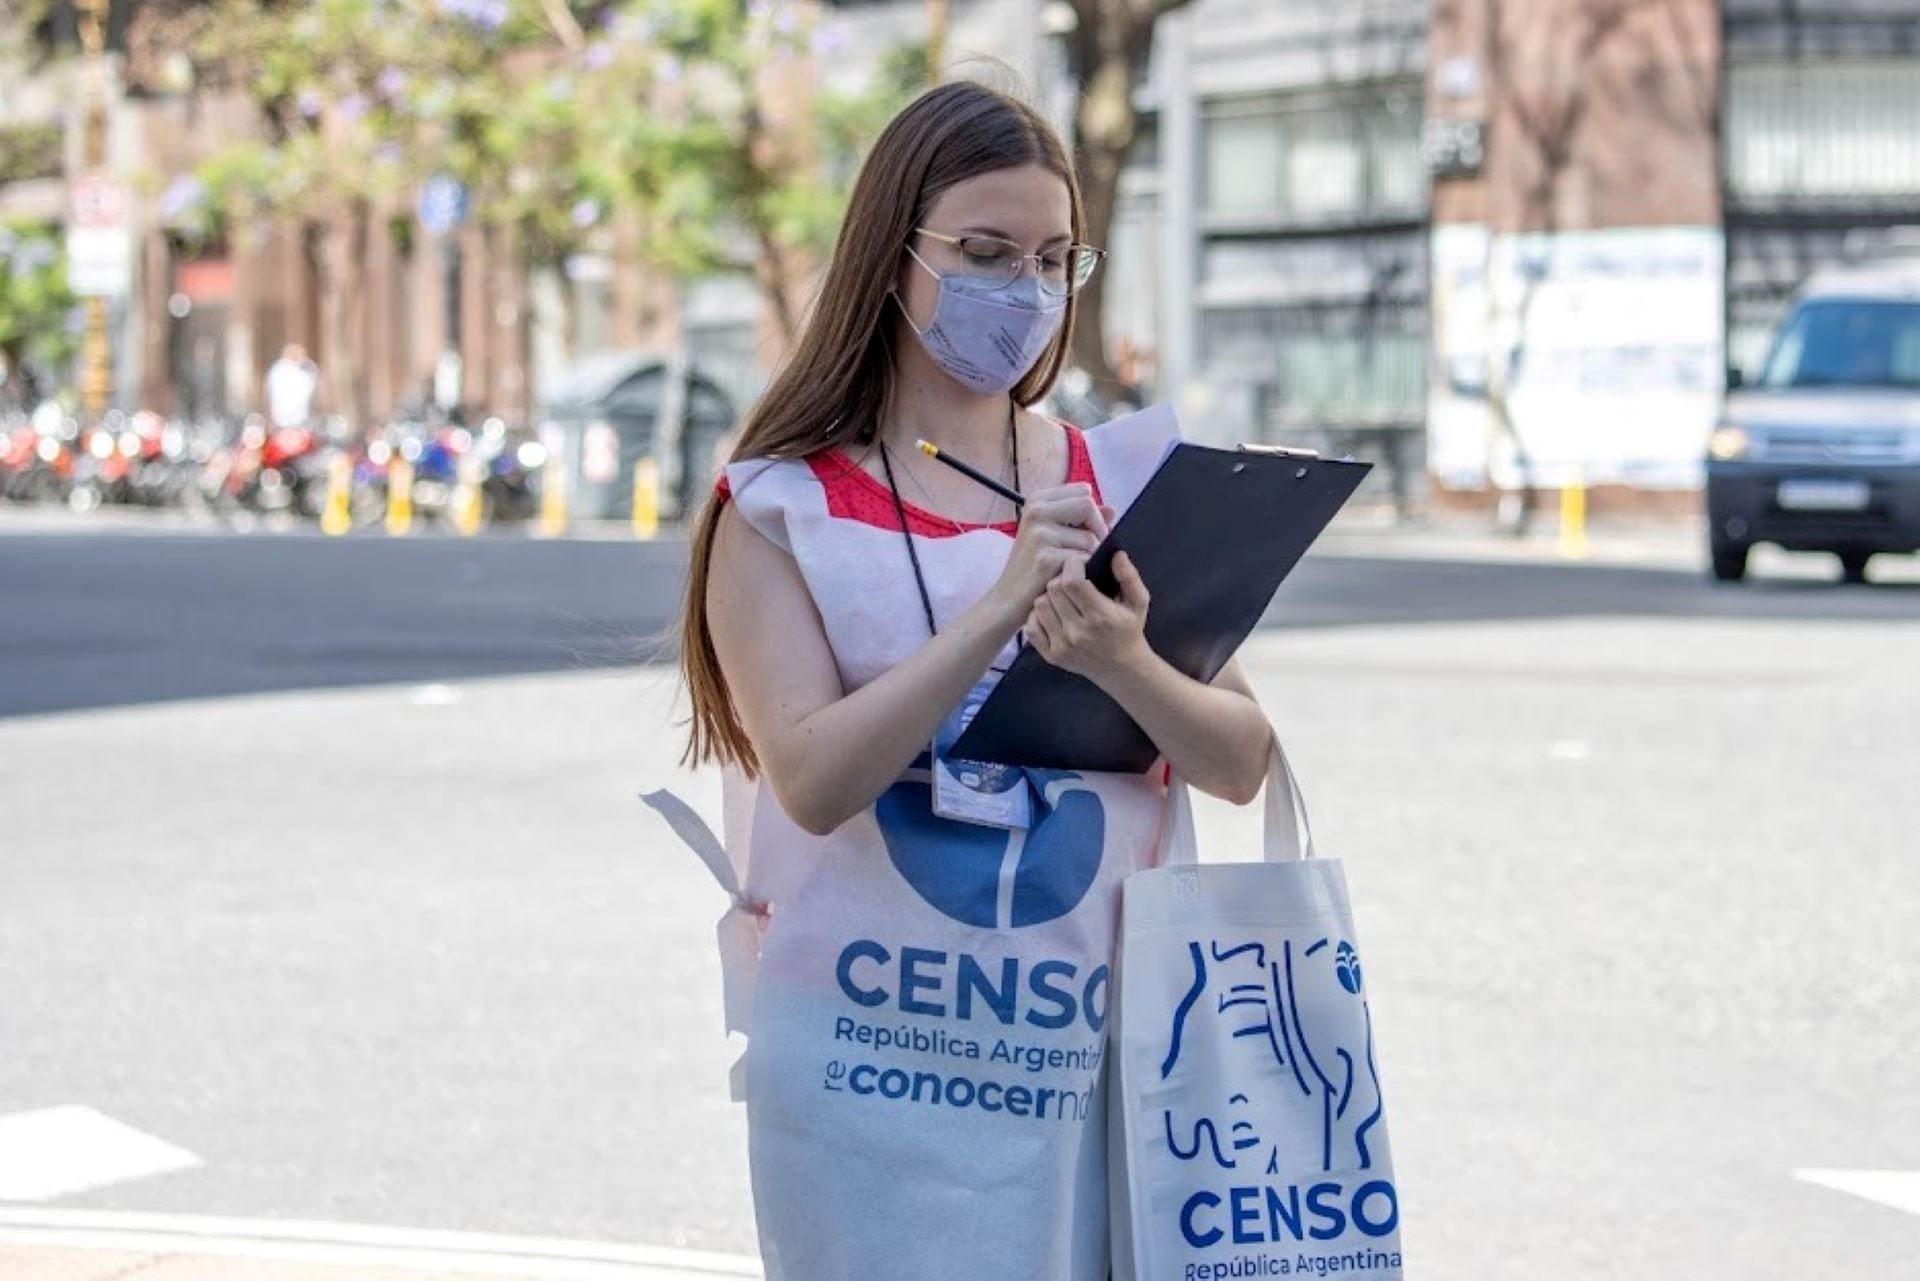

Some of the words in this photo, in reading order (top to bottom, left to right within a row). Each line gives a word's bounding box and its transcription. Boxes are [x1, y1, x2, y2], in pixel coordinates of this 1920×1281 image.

[836, 940, 1108, 1032] CENSO
[835, 1018, 979, 1059] República
[1179, 1180, 1398, 1248] CENSO
[1185, 1254, 1290, 1281] República
[1297, 1248, 1401, 1276] Argentina
